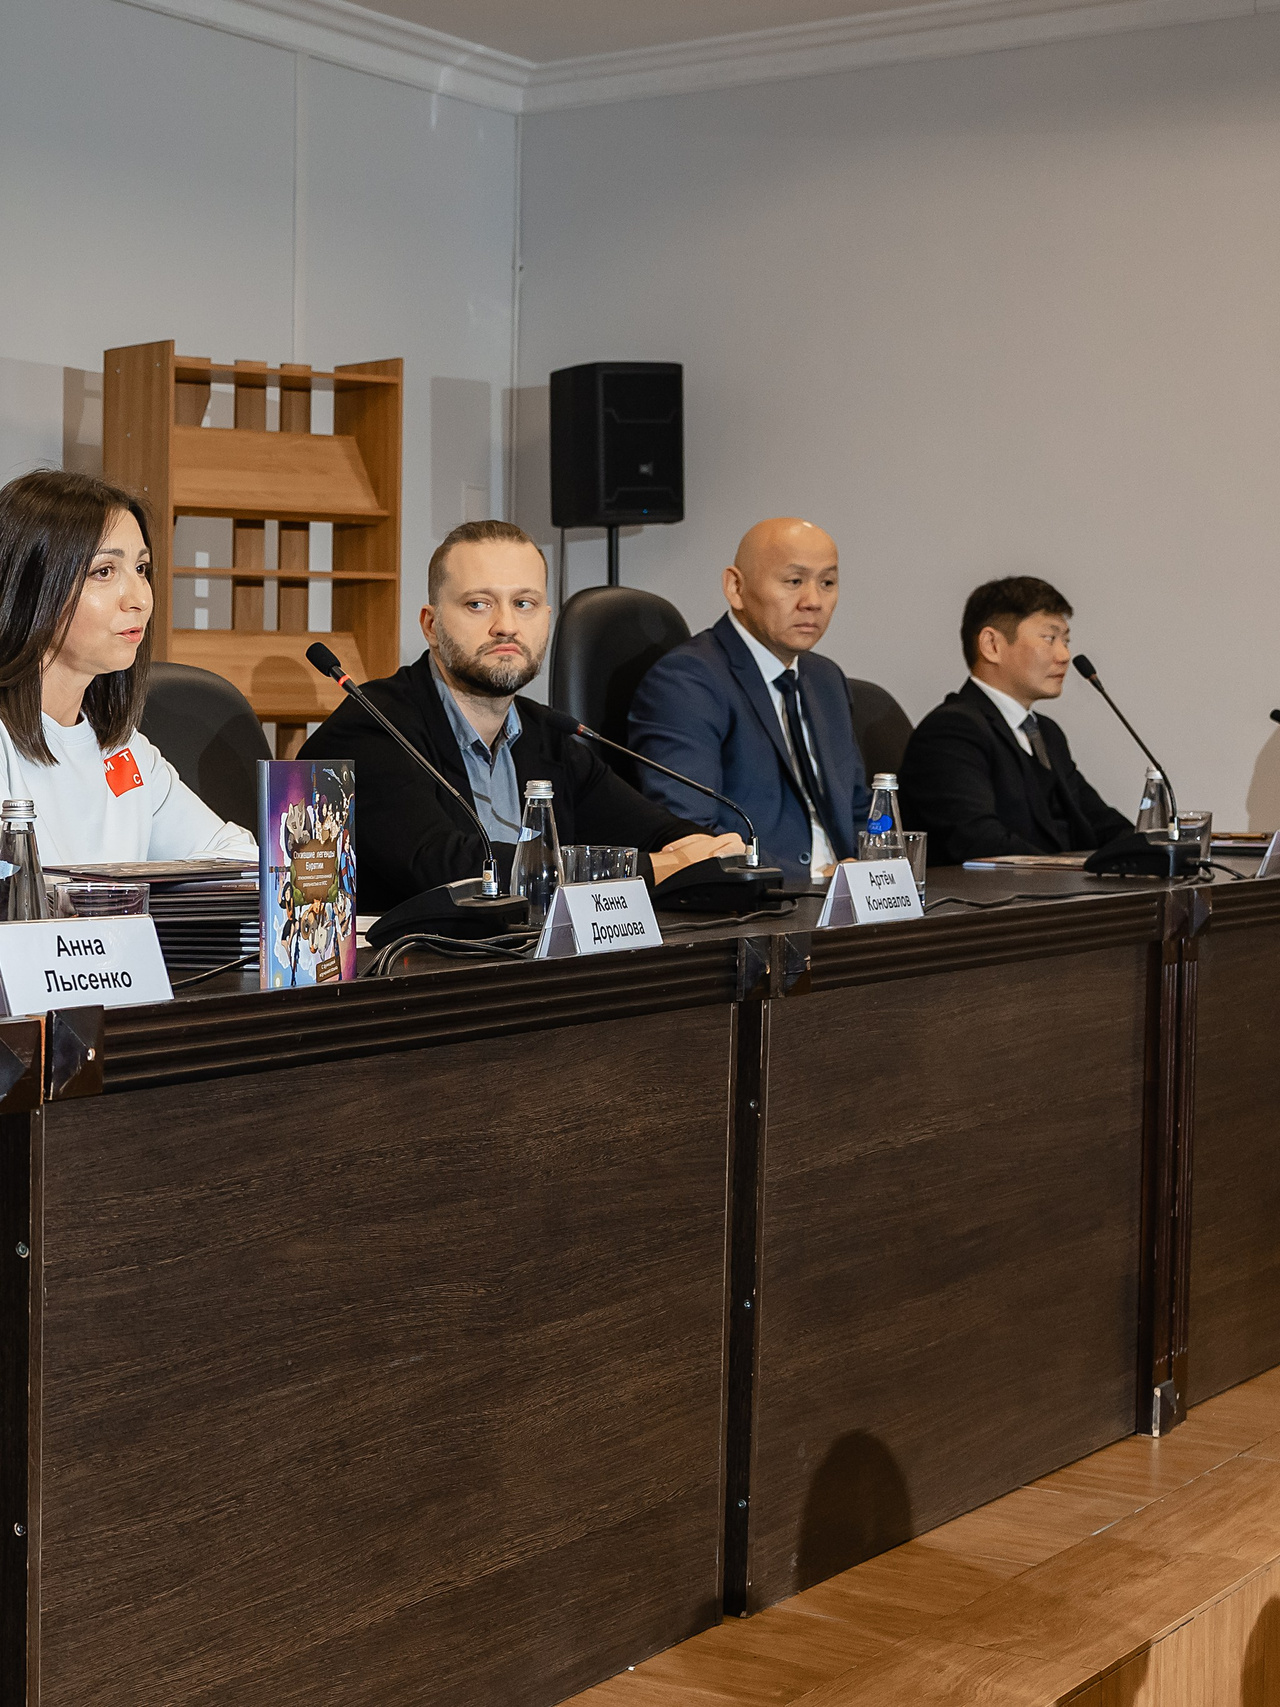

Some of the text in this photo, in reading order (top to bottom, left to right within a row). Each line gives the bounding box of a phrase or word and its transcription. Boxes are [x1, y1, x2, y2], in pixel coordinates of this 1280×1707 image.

[868, 870, 897, 890] Артём
[591, 893, 628, 912] Жанна
[865, 895, 912, 911] Коновалов
[591, 921, 645, 945] Дорошова
[56, 935, 106, 957] Анна
[43, 970, 132, 993] Лысенко
